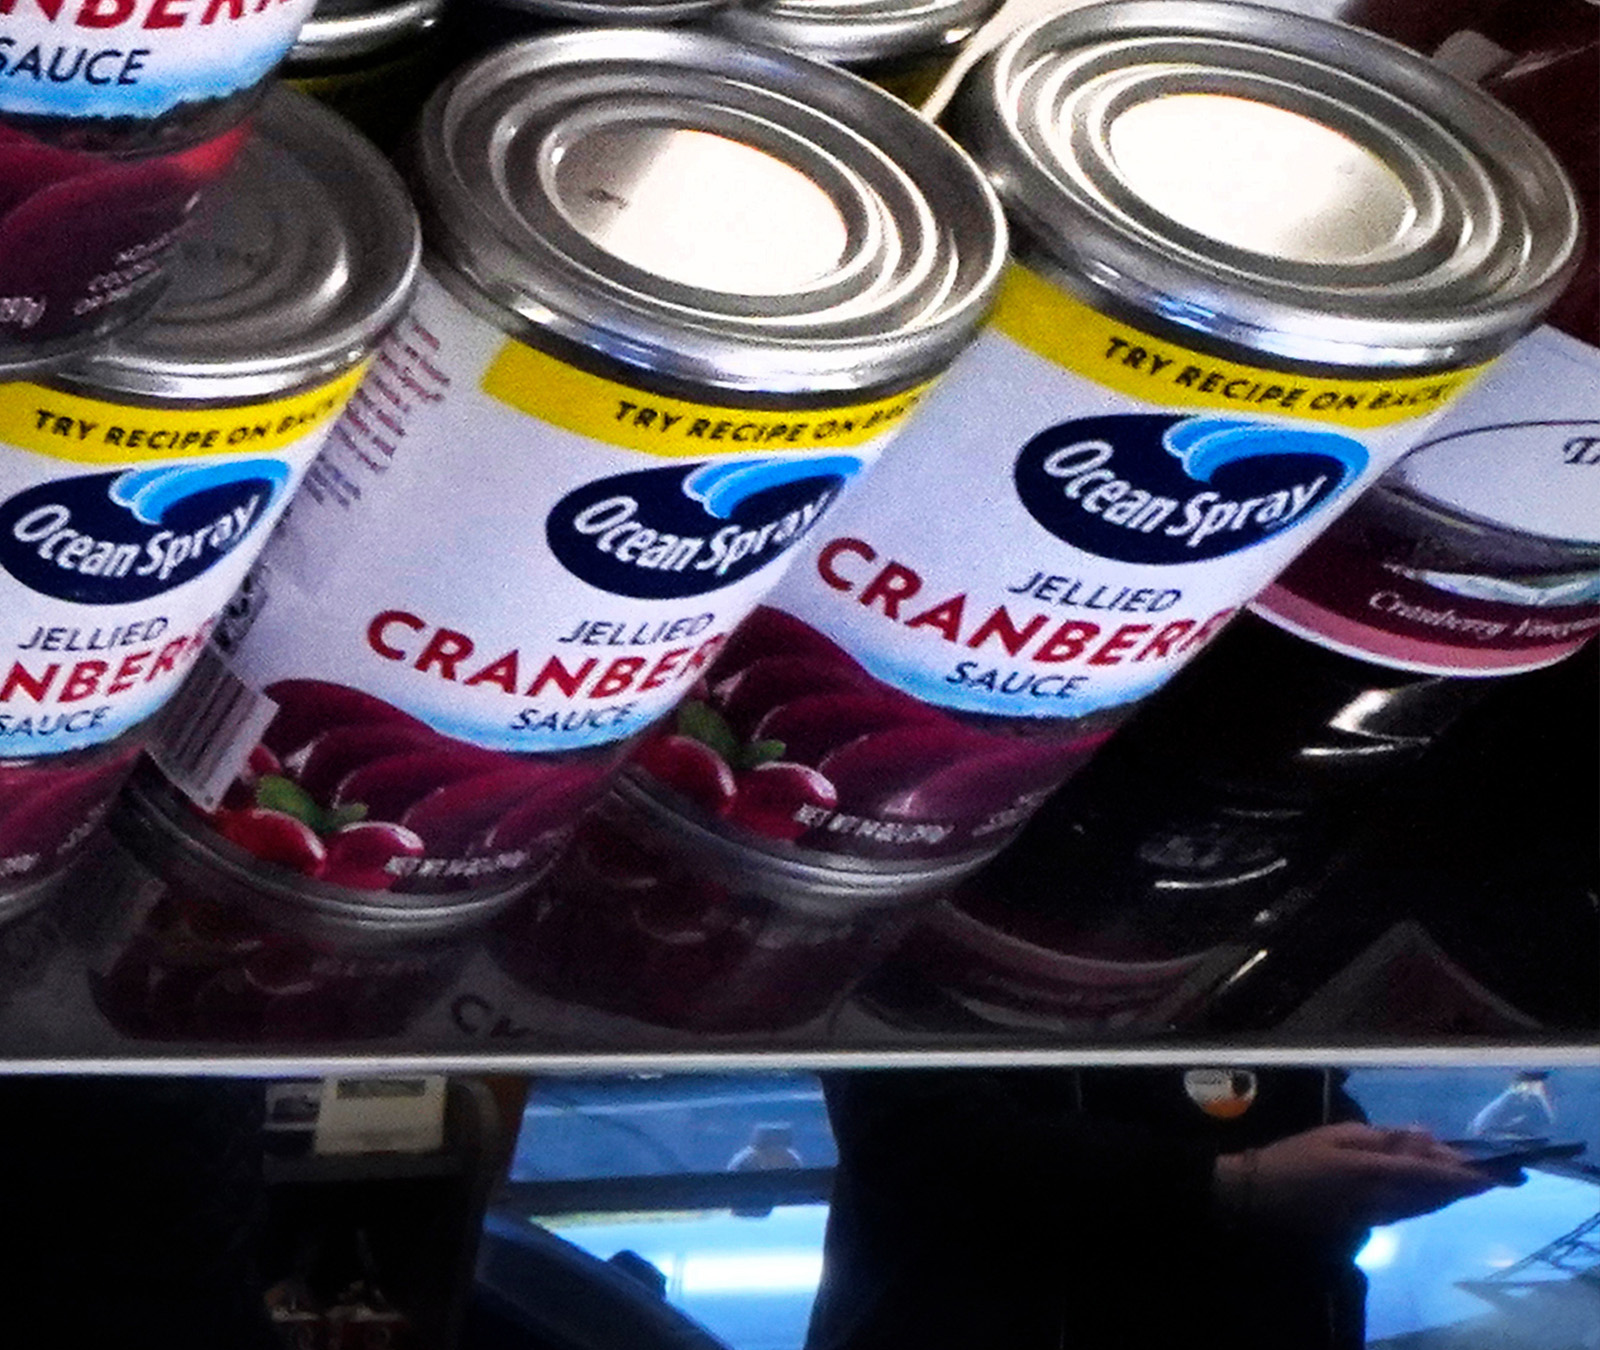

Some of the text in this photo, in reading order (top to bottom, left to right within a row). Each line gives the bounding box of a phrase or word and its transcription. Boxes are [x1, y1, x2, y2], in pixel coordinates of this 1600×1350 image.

[1103, 336, 1168, 377] TRY
[1173, 364, 1302, 410] RECIPE
[1310, 388, 1368, 411] ON
[34, 408, 271, 451] TRY RECIPE ON
[613, 400, 682, 433] TRY
[686, 418, 807, 444] RECIPE
[1007, 571, 1182, 615] JELLIED
[17, 615, 170, 654] JELLIED
[557, 611, 716, 647] JELLIED
[944, 660, 1089, 700] SAUCE
[510, 702, 644, 733] SAUCE
